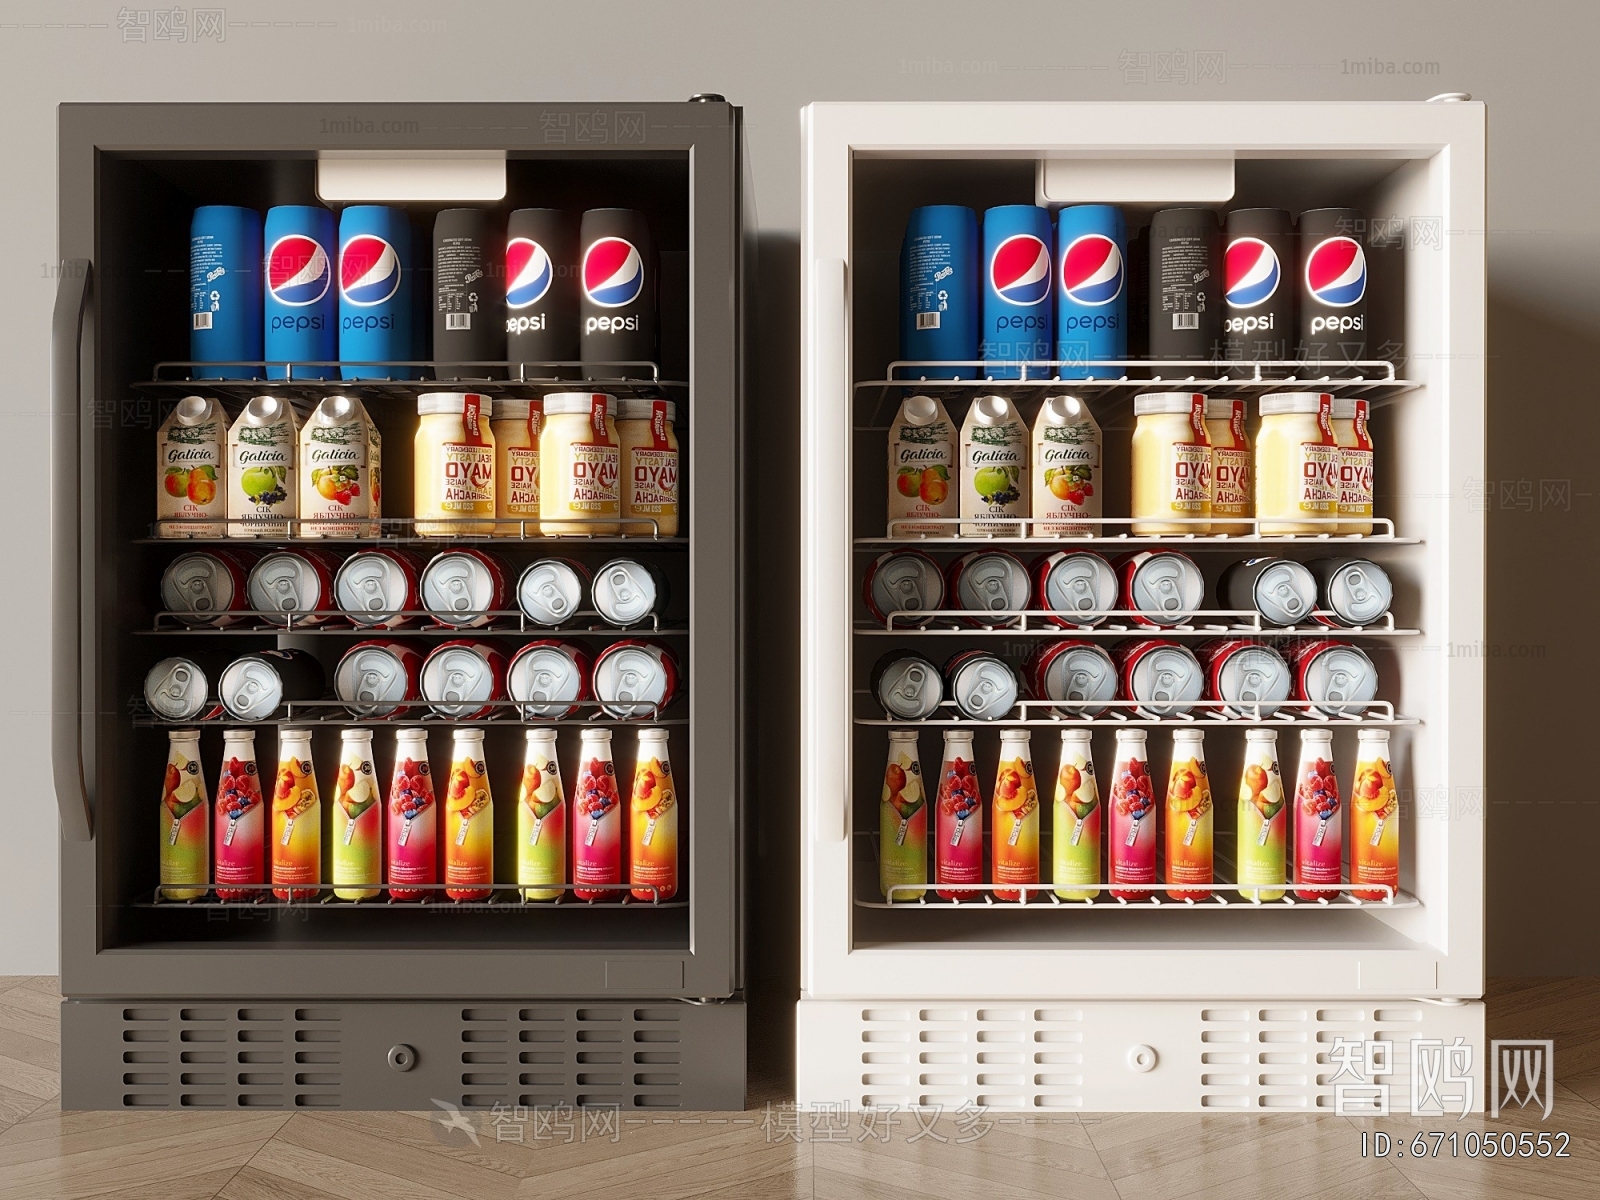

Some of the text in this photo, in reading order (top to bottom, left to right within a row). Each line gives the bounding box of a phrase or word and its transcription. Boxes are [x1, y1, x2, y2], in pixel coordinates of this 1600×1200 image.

[271, 314, 325, 333] pepsi
[342, 313, 395, 334] pepsi
[586, 314, 639, 335] pepsi
[996, 314, 1048, 333] pepsi
[1067, 313, 1119, 334] pepsi
[1311, 314, 1364, 335] pepsi
[168, 449, 214, 463] Galicia
[240, 450, 288, 465] Galicia
[311, 448, 360, 463] Galicia
[900, 448, 947, 463] Galicia
[972, 450, 1021, 464] Galicia
[1044, 448, 1093, 463] Galicia
[328, 504, 343, 512] СІК
[1061, 504, 1076, 512] СІК
[1301, 859, 1326, 867] vitalize
[1358, 859, 1383, 867] vitalize
